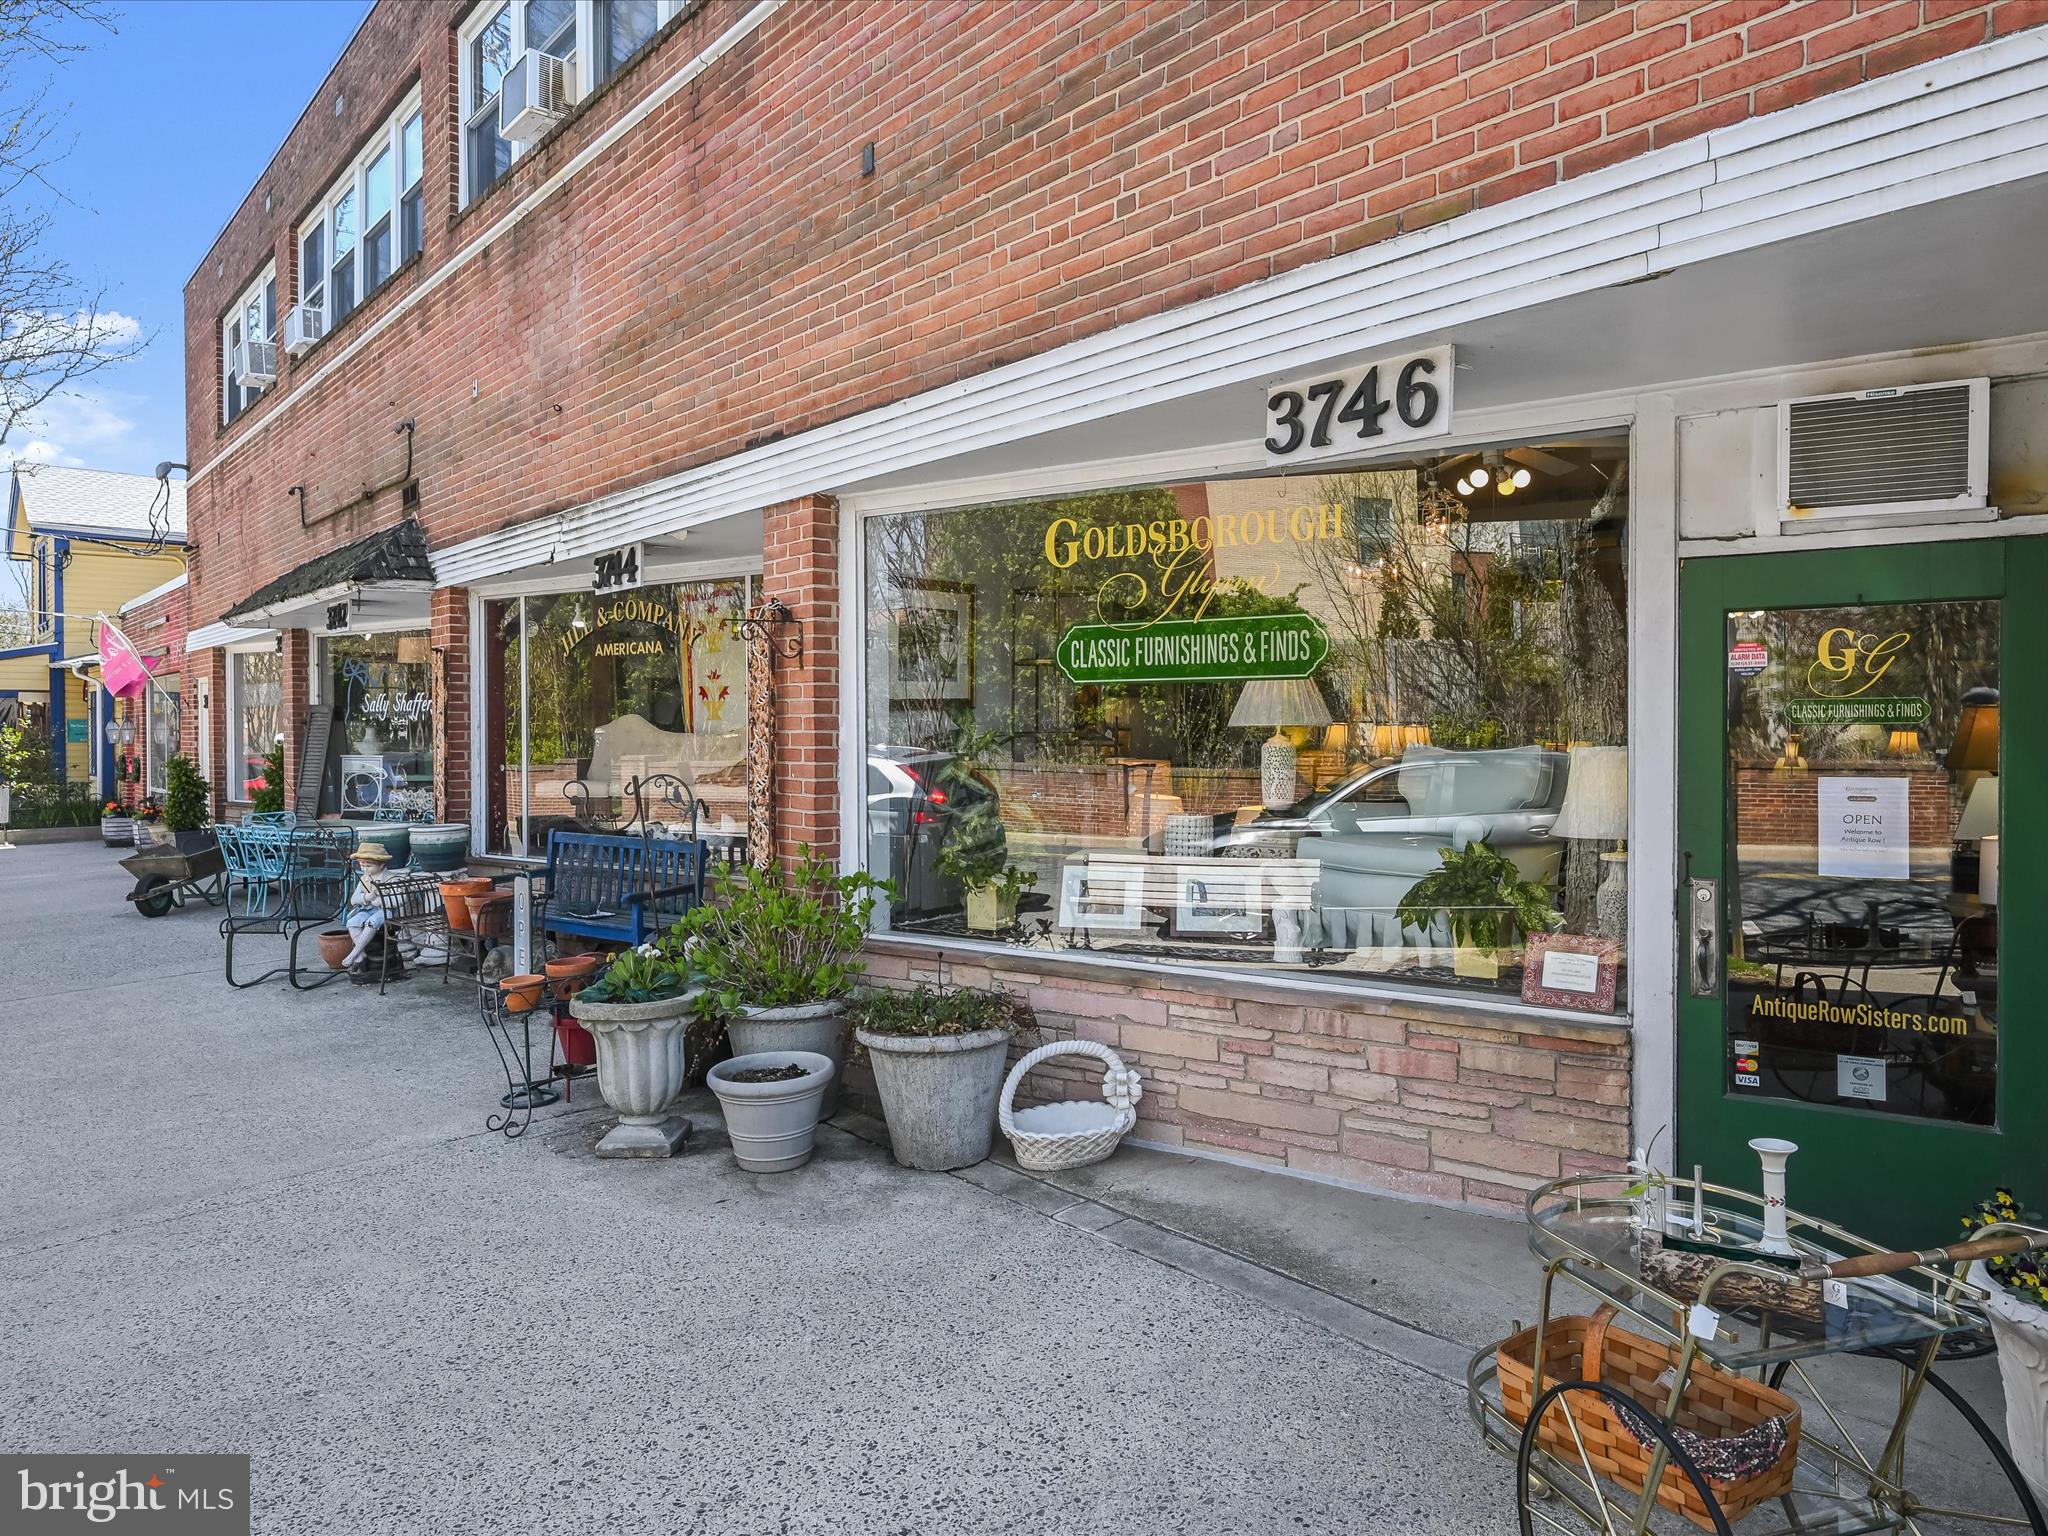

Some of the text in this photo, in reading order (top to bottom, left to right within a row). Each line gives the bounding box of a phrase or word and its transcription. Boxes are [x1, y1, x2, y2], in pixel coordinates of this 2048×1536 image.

[1265, 357, 1439, 455] 3746
[1045, 503, 1343, 569] GOLDSBOROUGH
[597, 606, 609, 629] &
[613, 599, 704, 649] COMPANY
[595, 640, 664, 657] AMERICANA
[1071, 629, 1311, 669] CLASSIC FURNISHINGS & FINDS
[361, 693, 390, 721] Sally
[1791, 703, 1923, 719] CLASSIC FURNISHINGS & FINDS
[1842, 813, 1883, 825] OPEN
[1841, 836, 1866, 844] Antique
[518, 893, 526, 968] OPE
[1752, 994, 1968, 1036] AntiqueRowSisters.com
[1737, 1076, 1759, 1085] VISA
